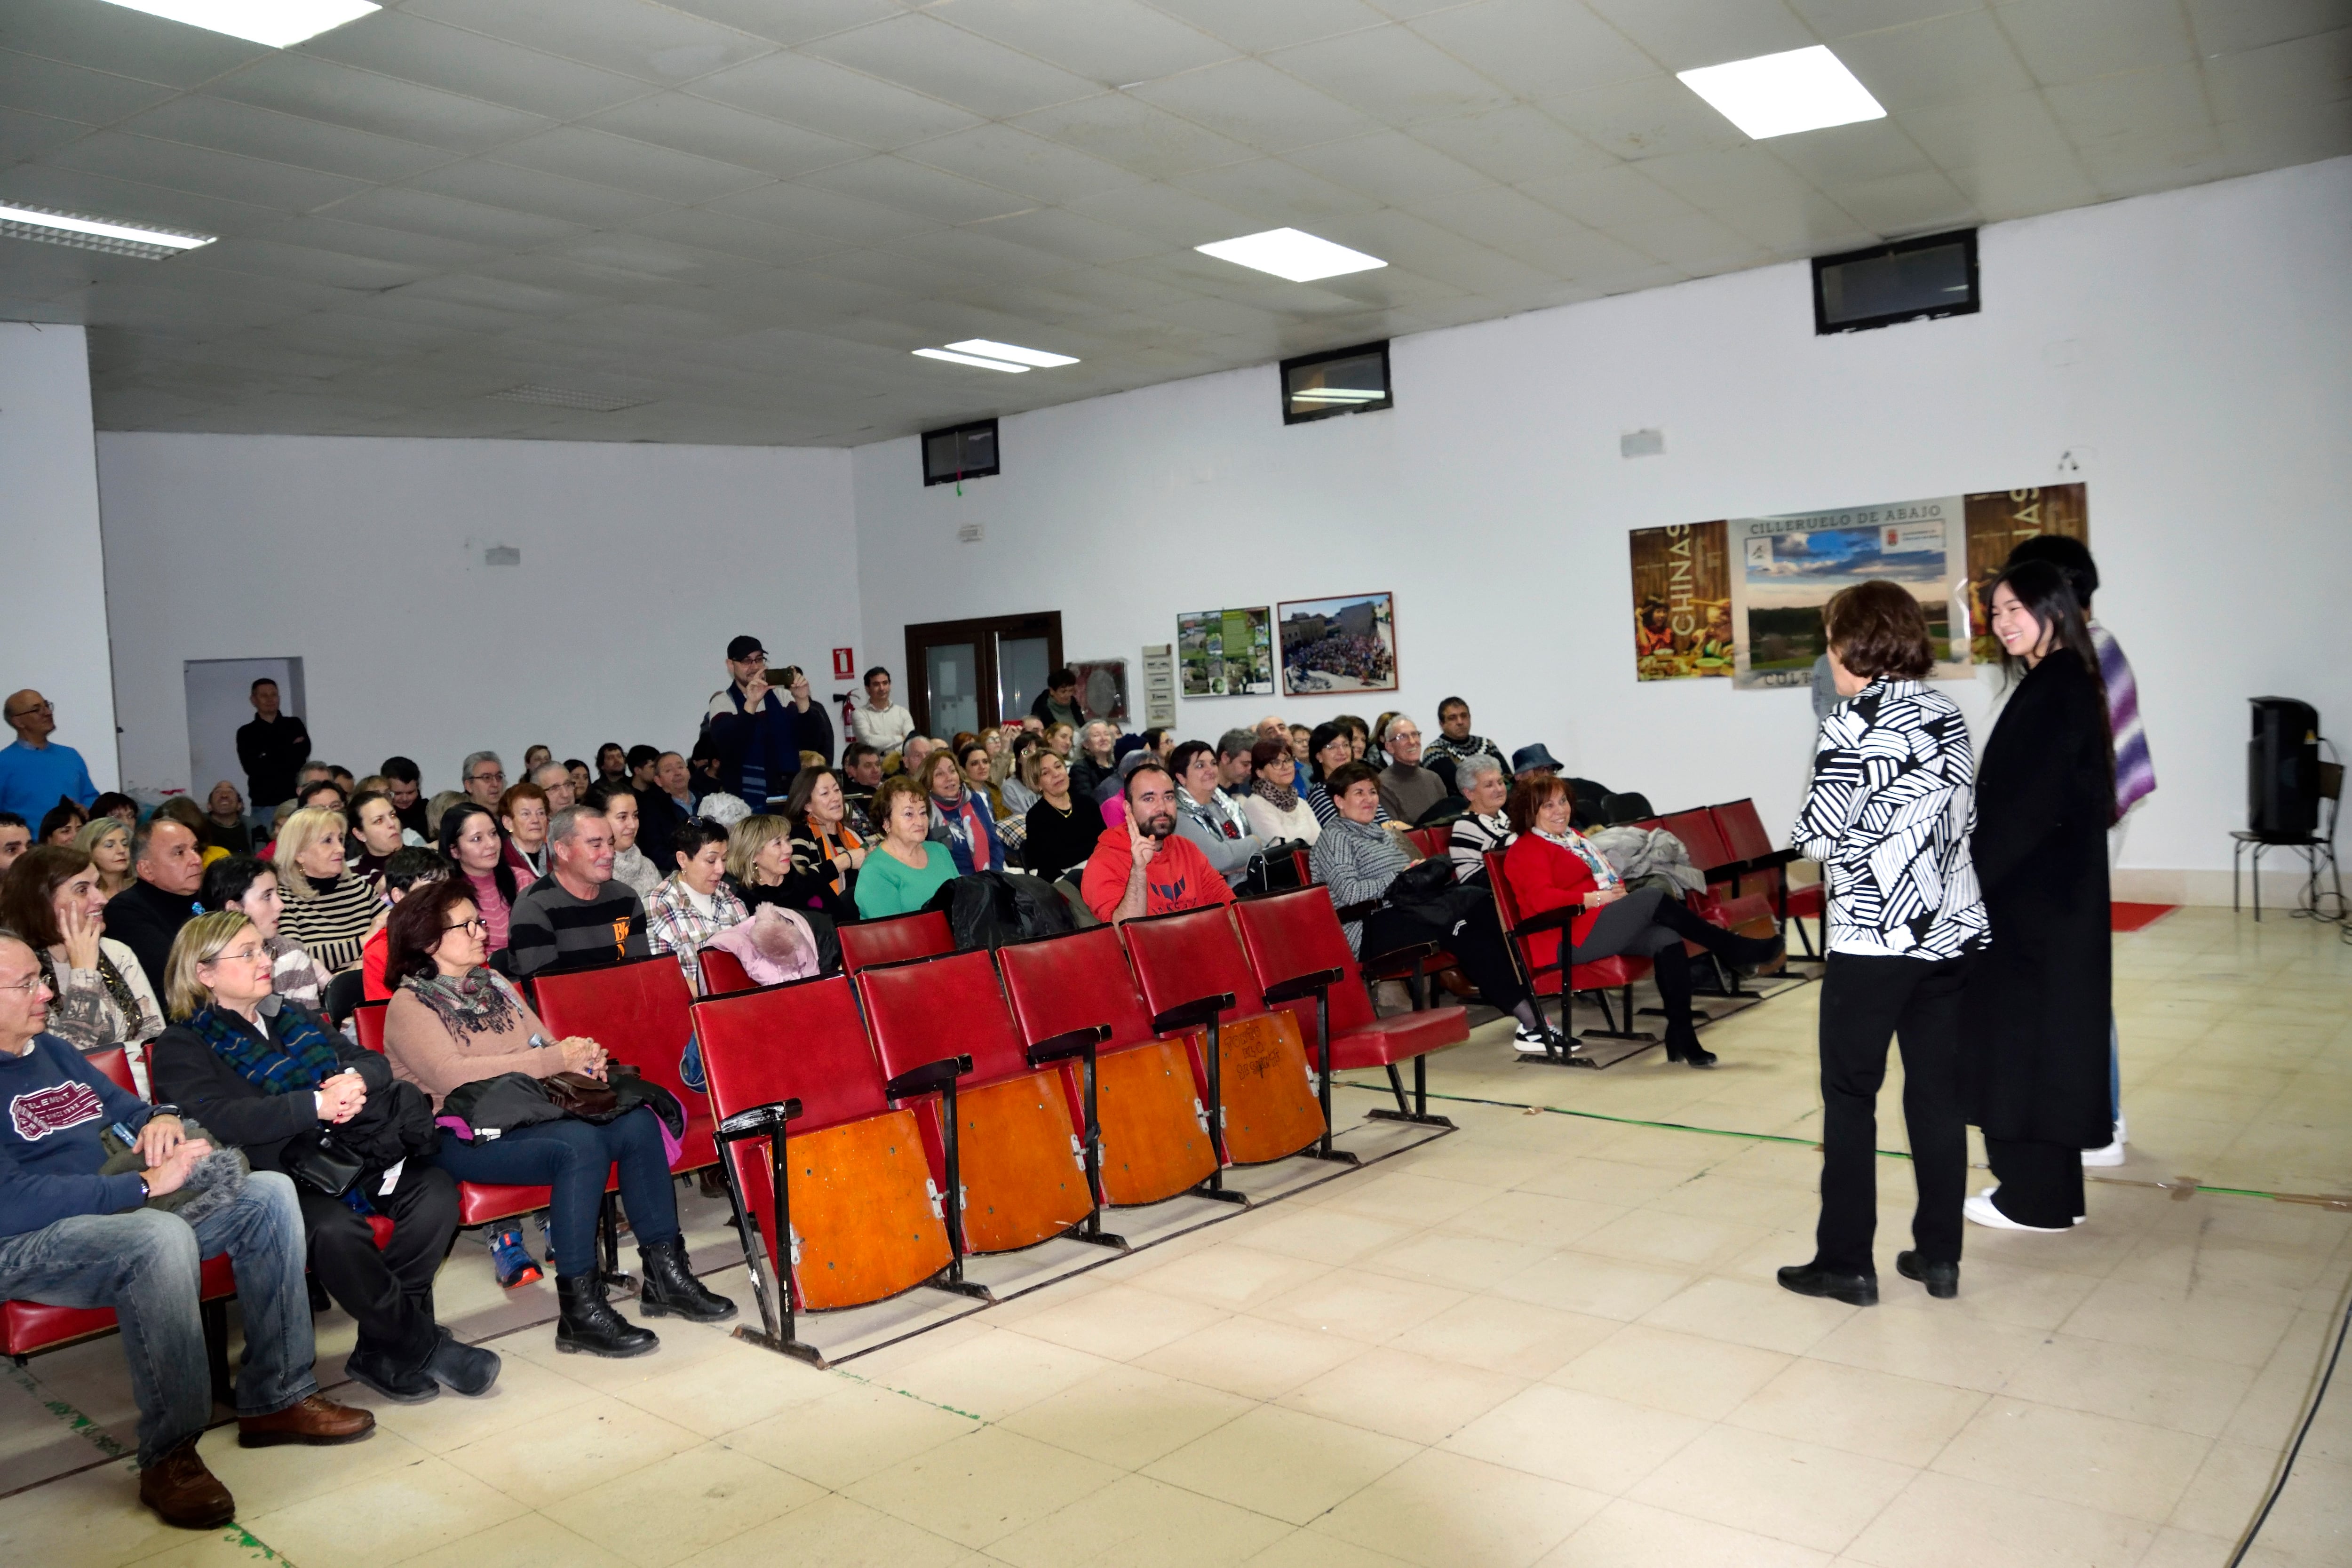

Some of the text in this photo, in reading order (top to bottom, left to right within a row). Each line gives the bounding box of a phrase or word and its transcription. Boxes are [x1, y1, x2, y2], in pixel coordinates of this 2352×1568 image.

[1749, 505, 1941, 534] CILLERUELO DE ABAJO
[1765, 673, 1812, 685] CULT
[26, 1092, 70, 1109] ELEMENT
